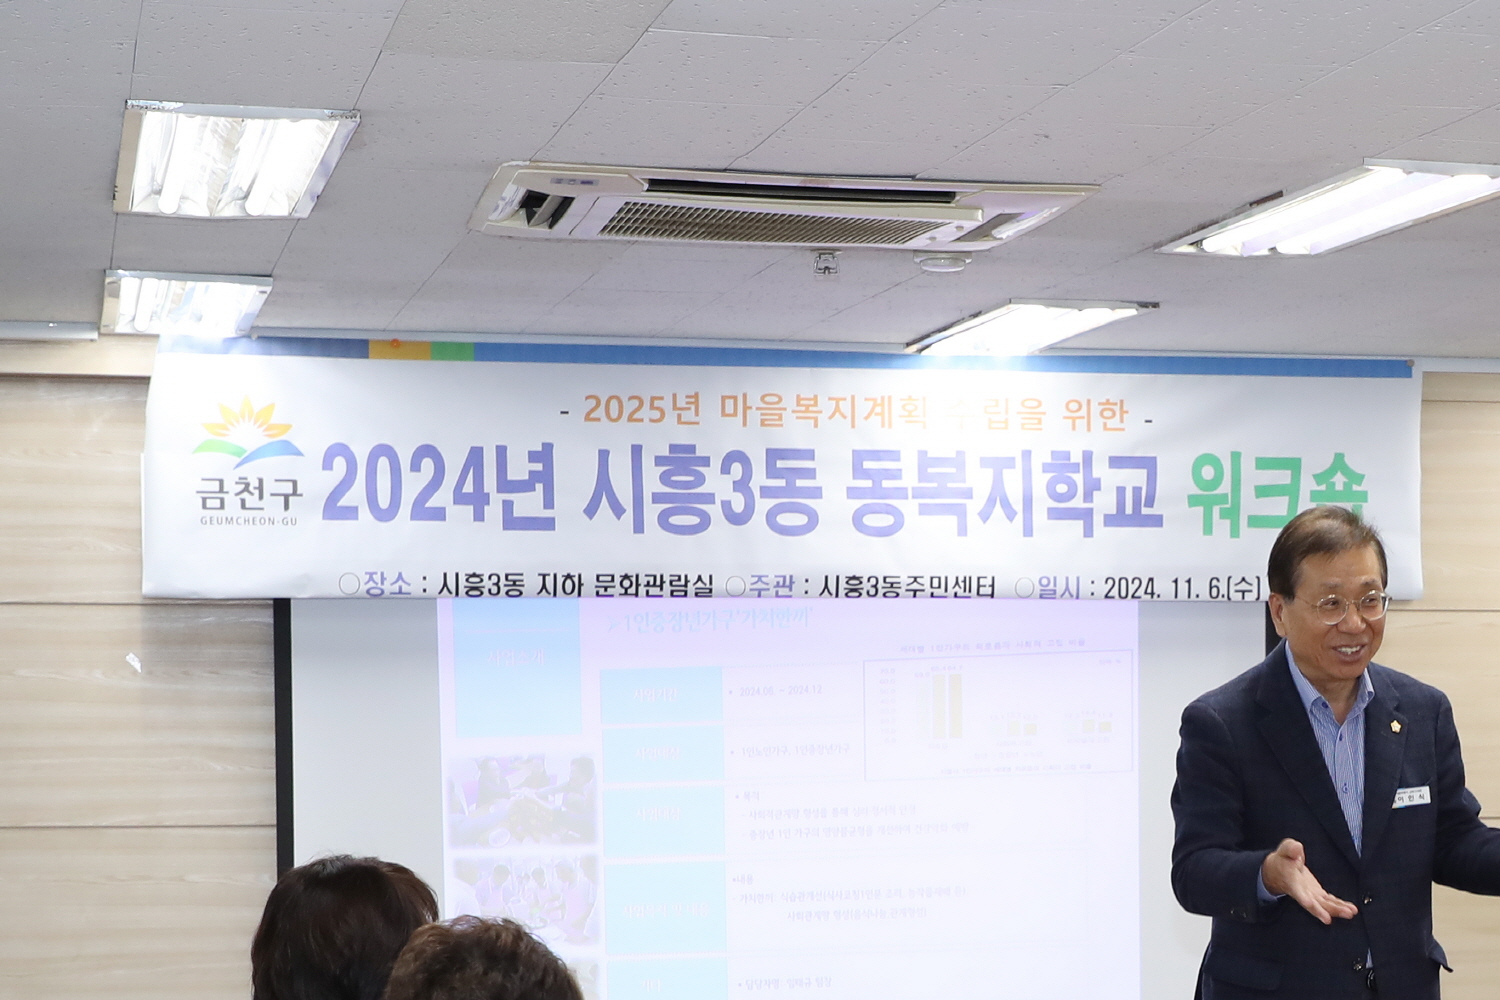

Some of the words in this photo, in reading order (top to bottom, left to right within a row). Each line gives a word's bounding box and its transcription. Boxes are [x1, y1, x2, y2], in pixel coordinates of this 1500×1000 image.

[583, 391, 701, 426] 2025년
[719, 392, 928, 430] 마을복지계획
[1062, 397, 1129, 432] 위한
[195, 476, 303, 512] 금천구
[321, 442, 556, 531] 2024년
[582, 442, 823, 538] 시흥3동
[845, 447, 1163, 538] 동복지학교
[200, 515, 298, 526] GEUMCHEON-GU
[439, 572, 525, 597] 시흥3동
[537, 572, 584, 597] 지하
[595, 573, 714, 598] 문화관람실
[819, 574, 995, 599] 시흥3동주민센터
[1104, 577, 1161, 600] 2024.
[1171, 577, 1202, 600] 11.
[1209, 576, 1262, 601] 6.(수)
